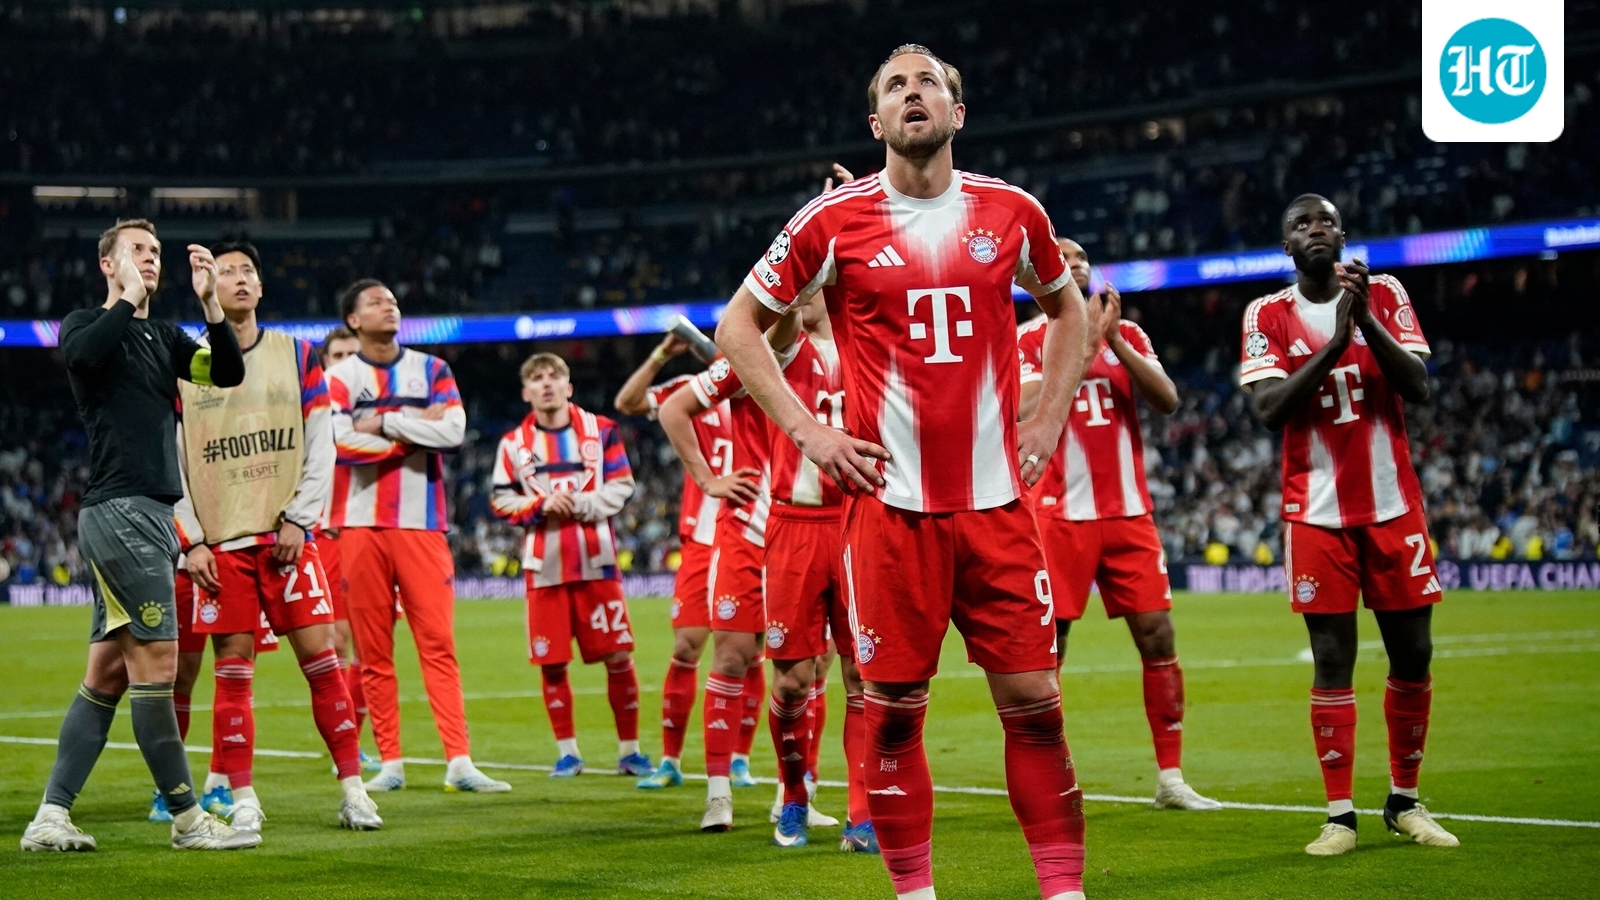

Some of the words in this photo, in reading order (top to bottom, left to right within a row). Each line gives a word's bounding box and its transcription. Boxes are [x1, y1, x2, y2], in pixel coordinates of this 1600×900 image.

[907, 286, 973, 364] T
[1075, 377, 1114, 427] T
[1319, 363, 1364, 425] T
[1406, 533, 1430, 577] 2
[1469, 563, 1535, 591] UEFA
[279, 562, 324, 602] 21
[1034, 569, 1054, 626] 9
[591, 600, 628, 634] 42
